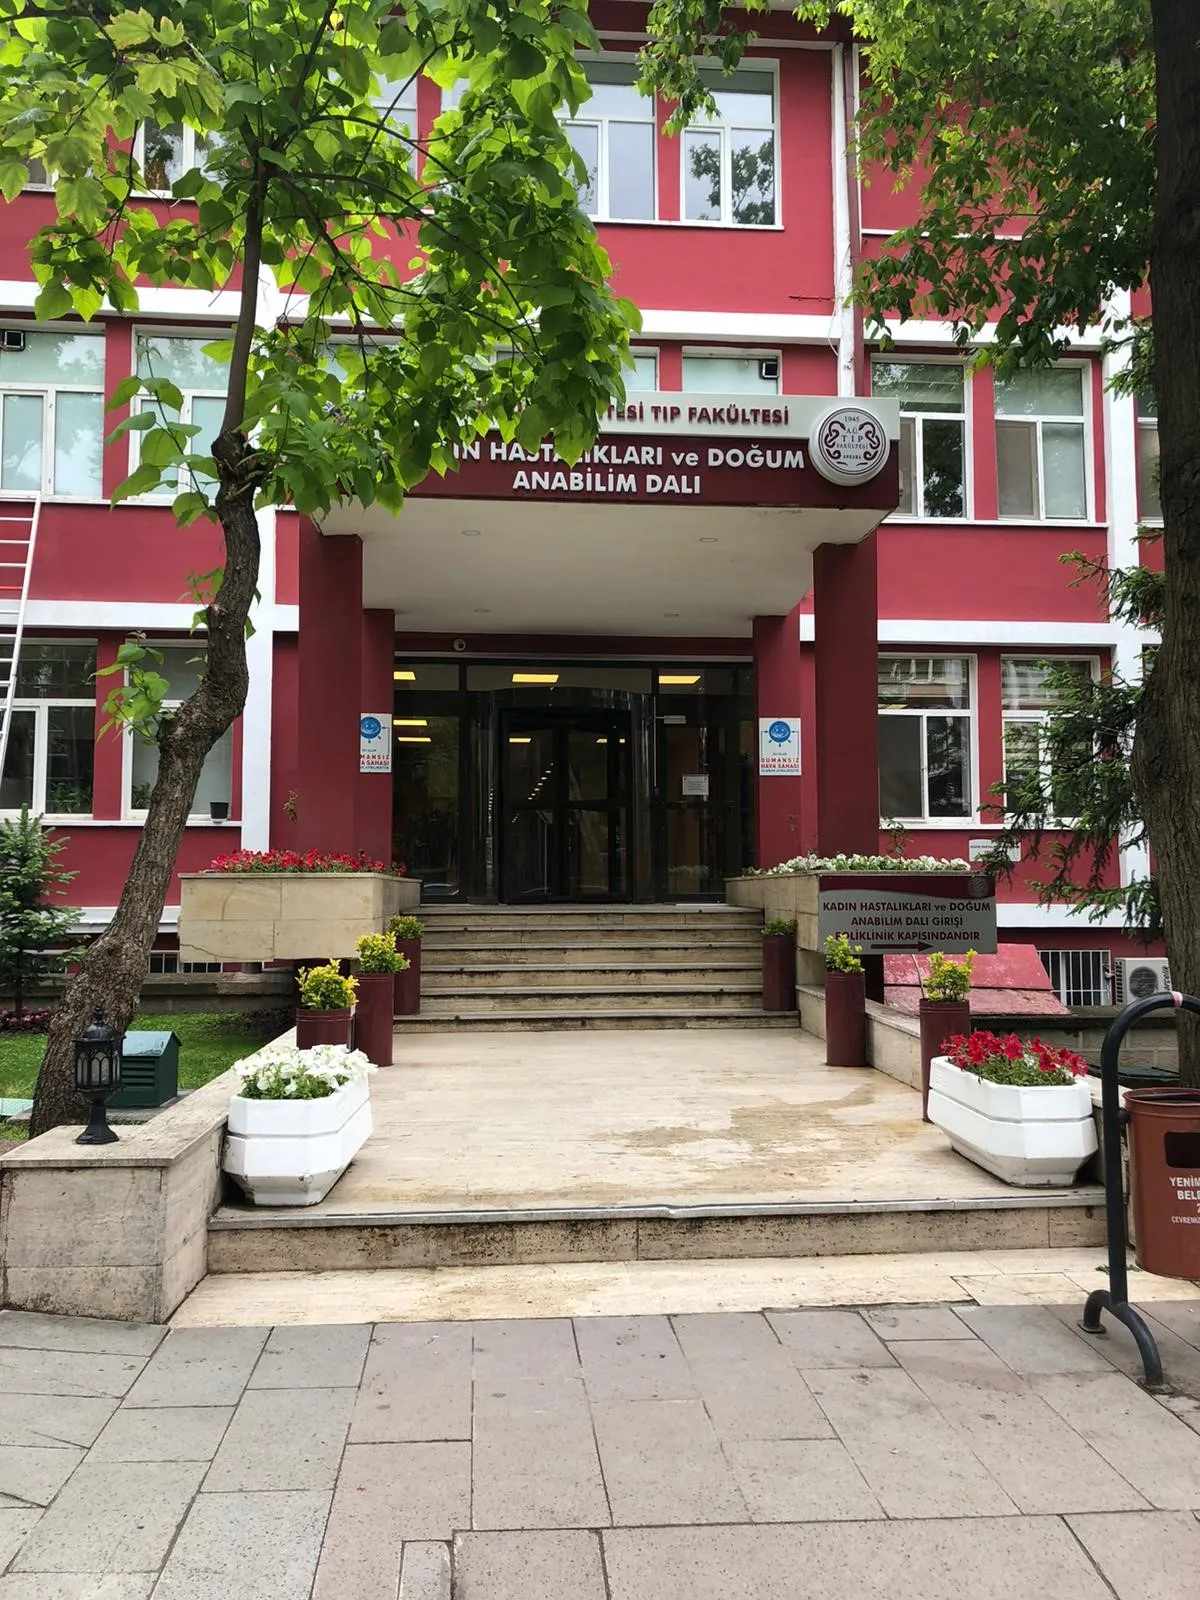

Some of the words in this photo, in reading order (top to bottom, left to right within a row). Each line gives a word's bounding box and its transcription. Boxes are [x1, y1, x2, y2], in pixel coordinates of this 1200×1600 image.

[651, 405, 681, 421] TIP
[688, 404, 789, 425] FAKÜLTESİ
[490, 441, 662, 465] HATIKLARI
[671, 452, 699, 466] ve
[708, 444, 804, 469] DOĞUM
[513, 468, 637, 492] ANABİLİM
[646, 475, 700, 494] DALI
[823, 902, 857, 911] KADIN
[860, 902, 931, 911] HASTALIKLARI
[949, 901, 991, 911] DOĞUM
[851, 914, 903, 926] ANABİLİM
[906, 916, 929, 926] DALI
[932, 914, 963, 928] GİRİŞİ
[897, 931, 980, 941] KAPISINDANDIR
